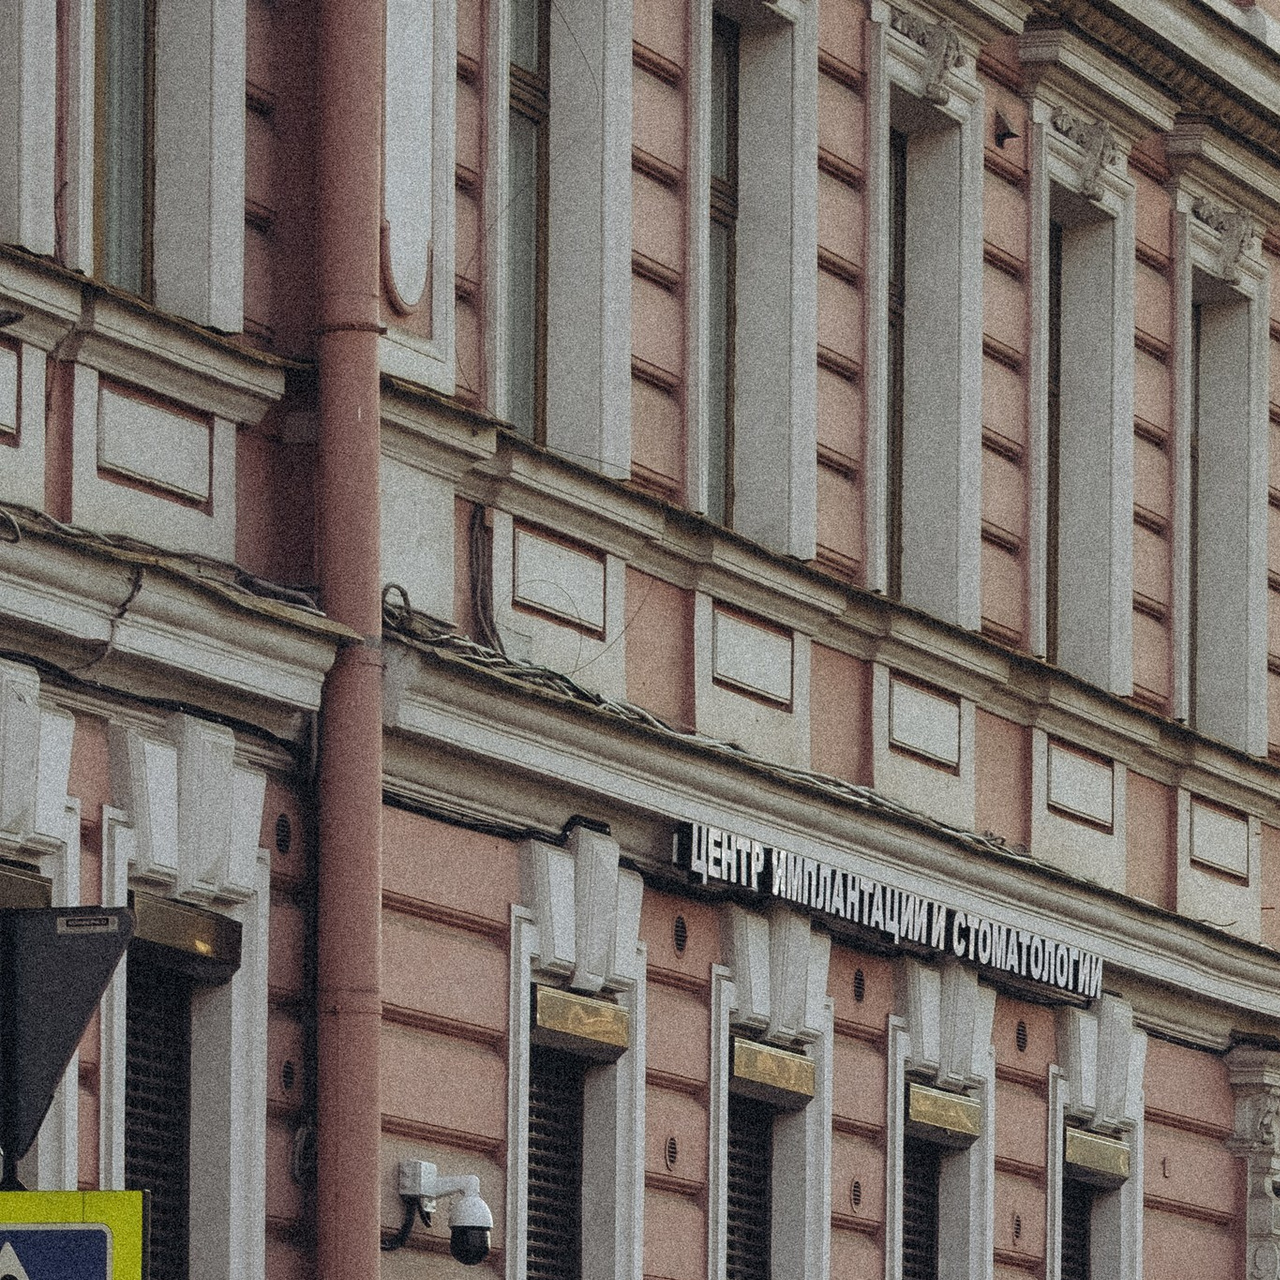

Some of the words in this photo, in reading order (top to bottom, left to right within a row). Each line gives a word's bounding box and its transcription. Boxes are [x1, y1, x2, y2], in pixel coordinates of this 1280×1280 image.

[691, 822, 765, 893] ЦЕНТР
[771, 846, 929, 945] ИМПЛАНТАЦИИ
[930, 900, 947, 950] И
[952, 910, 1104, 999] СТОМАТОЛОГИИ
